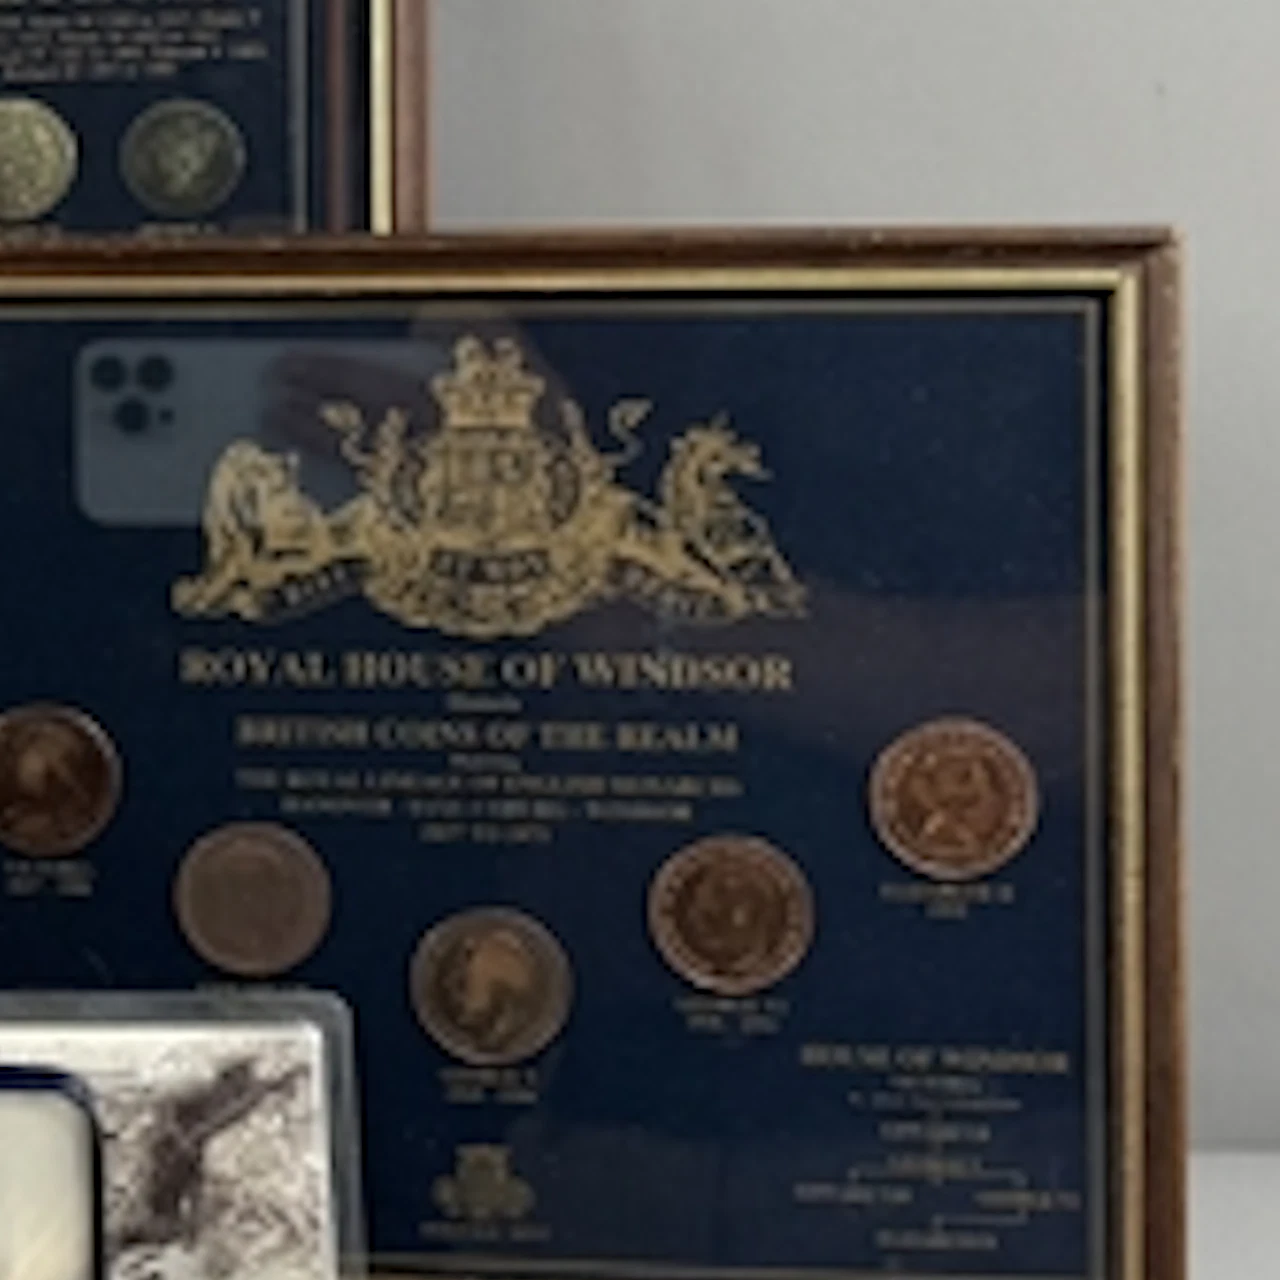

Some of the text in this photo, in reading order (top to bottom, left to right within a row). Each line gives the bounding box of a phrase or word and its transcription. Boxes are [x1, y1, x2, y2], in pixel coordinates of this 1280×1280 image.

[181, 650, 794, 692] ROYAL HOUSE OF WINDSOR
[236, 714, 368, 748] BRITISH
[485, 719, 532, 751] OF
[540, 720, 608, 751] THE
[615, 720, 739, 754] REALM
